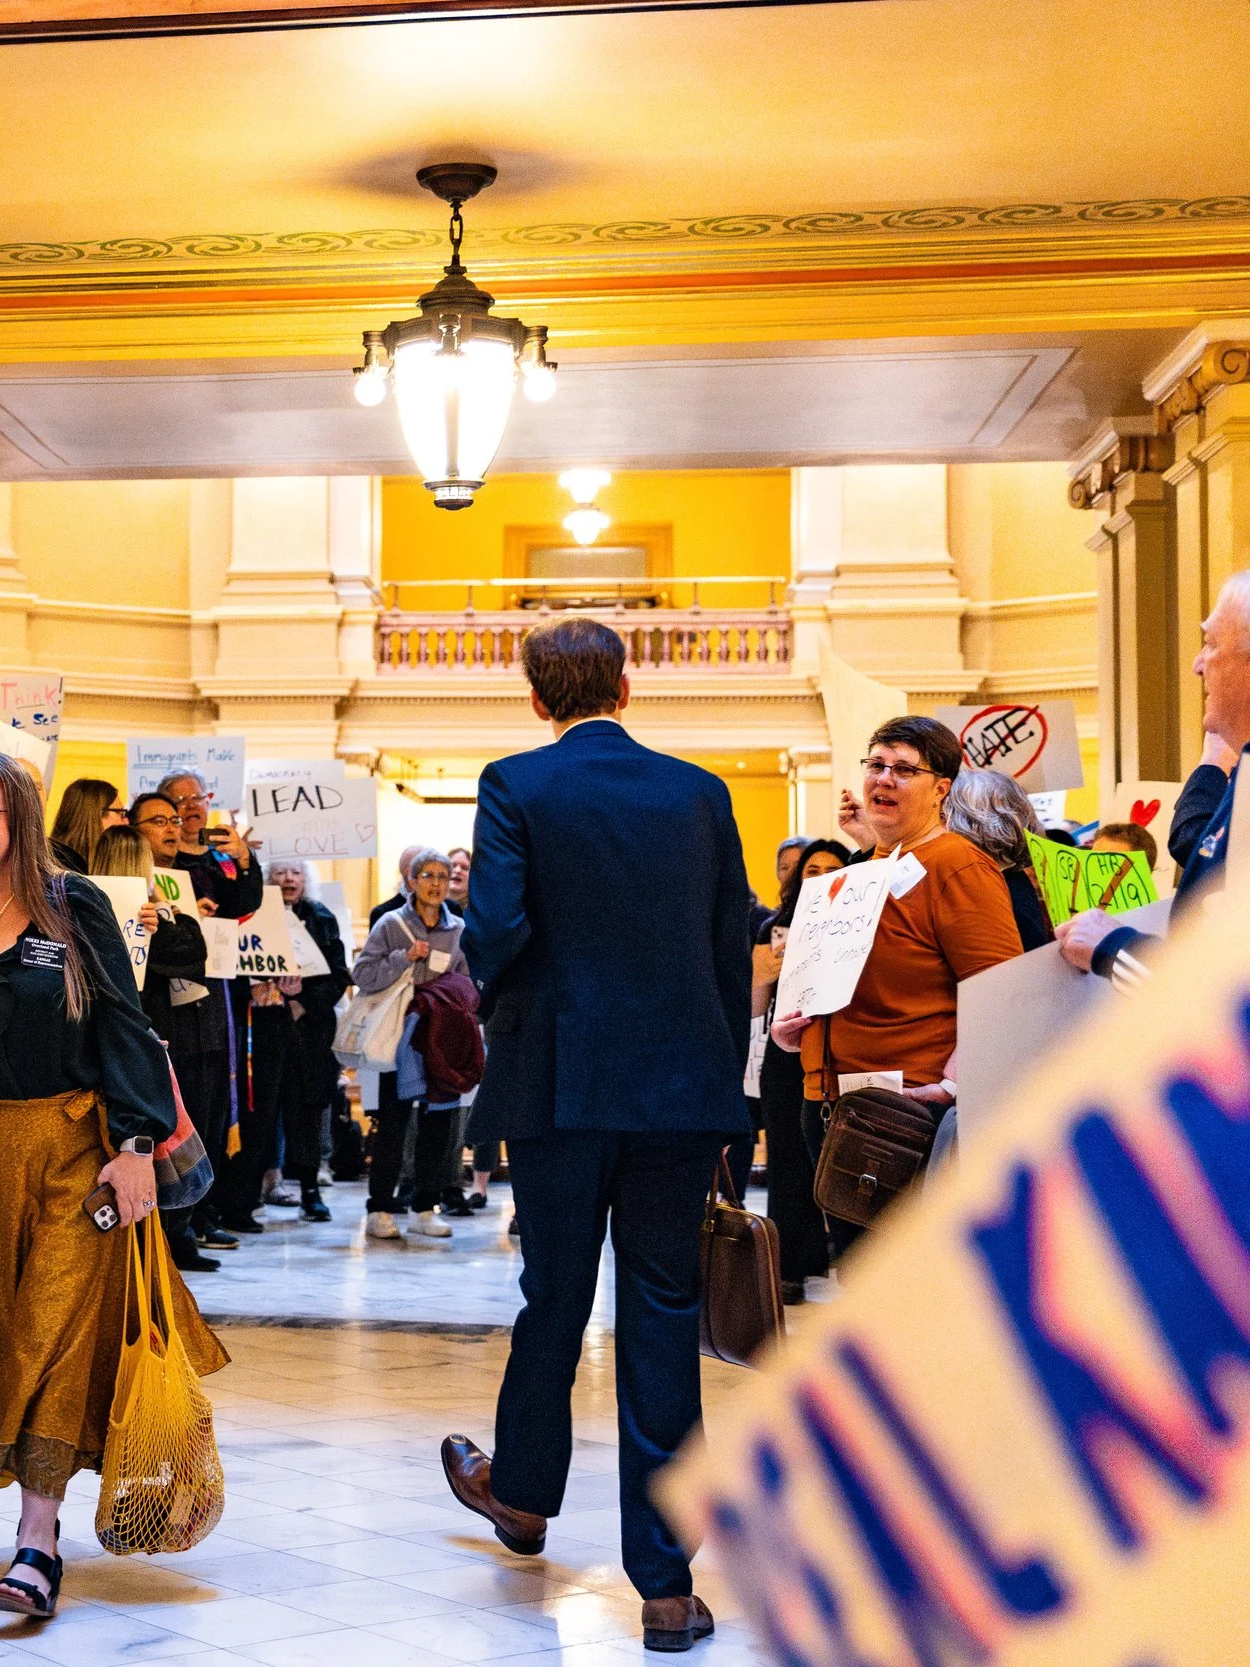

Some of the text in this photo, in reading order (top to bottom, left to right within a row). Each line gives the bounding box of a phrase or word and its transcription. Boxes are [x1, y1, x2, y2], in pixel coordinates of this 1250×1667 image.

[962, 706, 1035, 768] HATE
[251, 784, 344, 817] LEAD
[268, 831, 350, 855] LOVE
[237, 933, 264, 953] UR
[235, 954, 289, 973] HBOR
